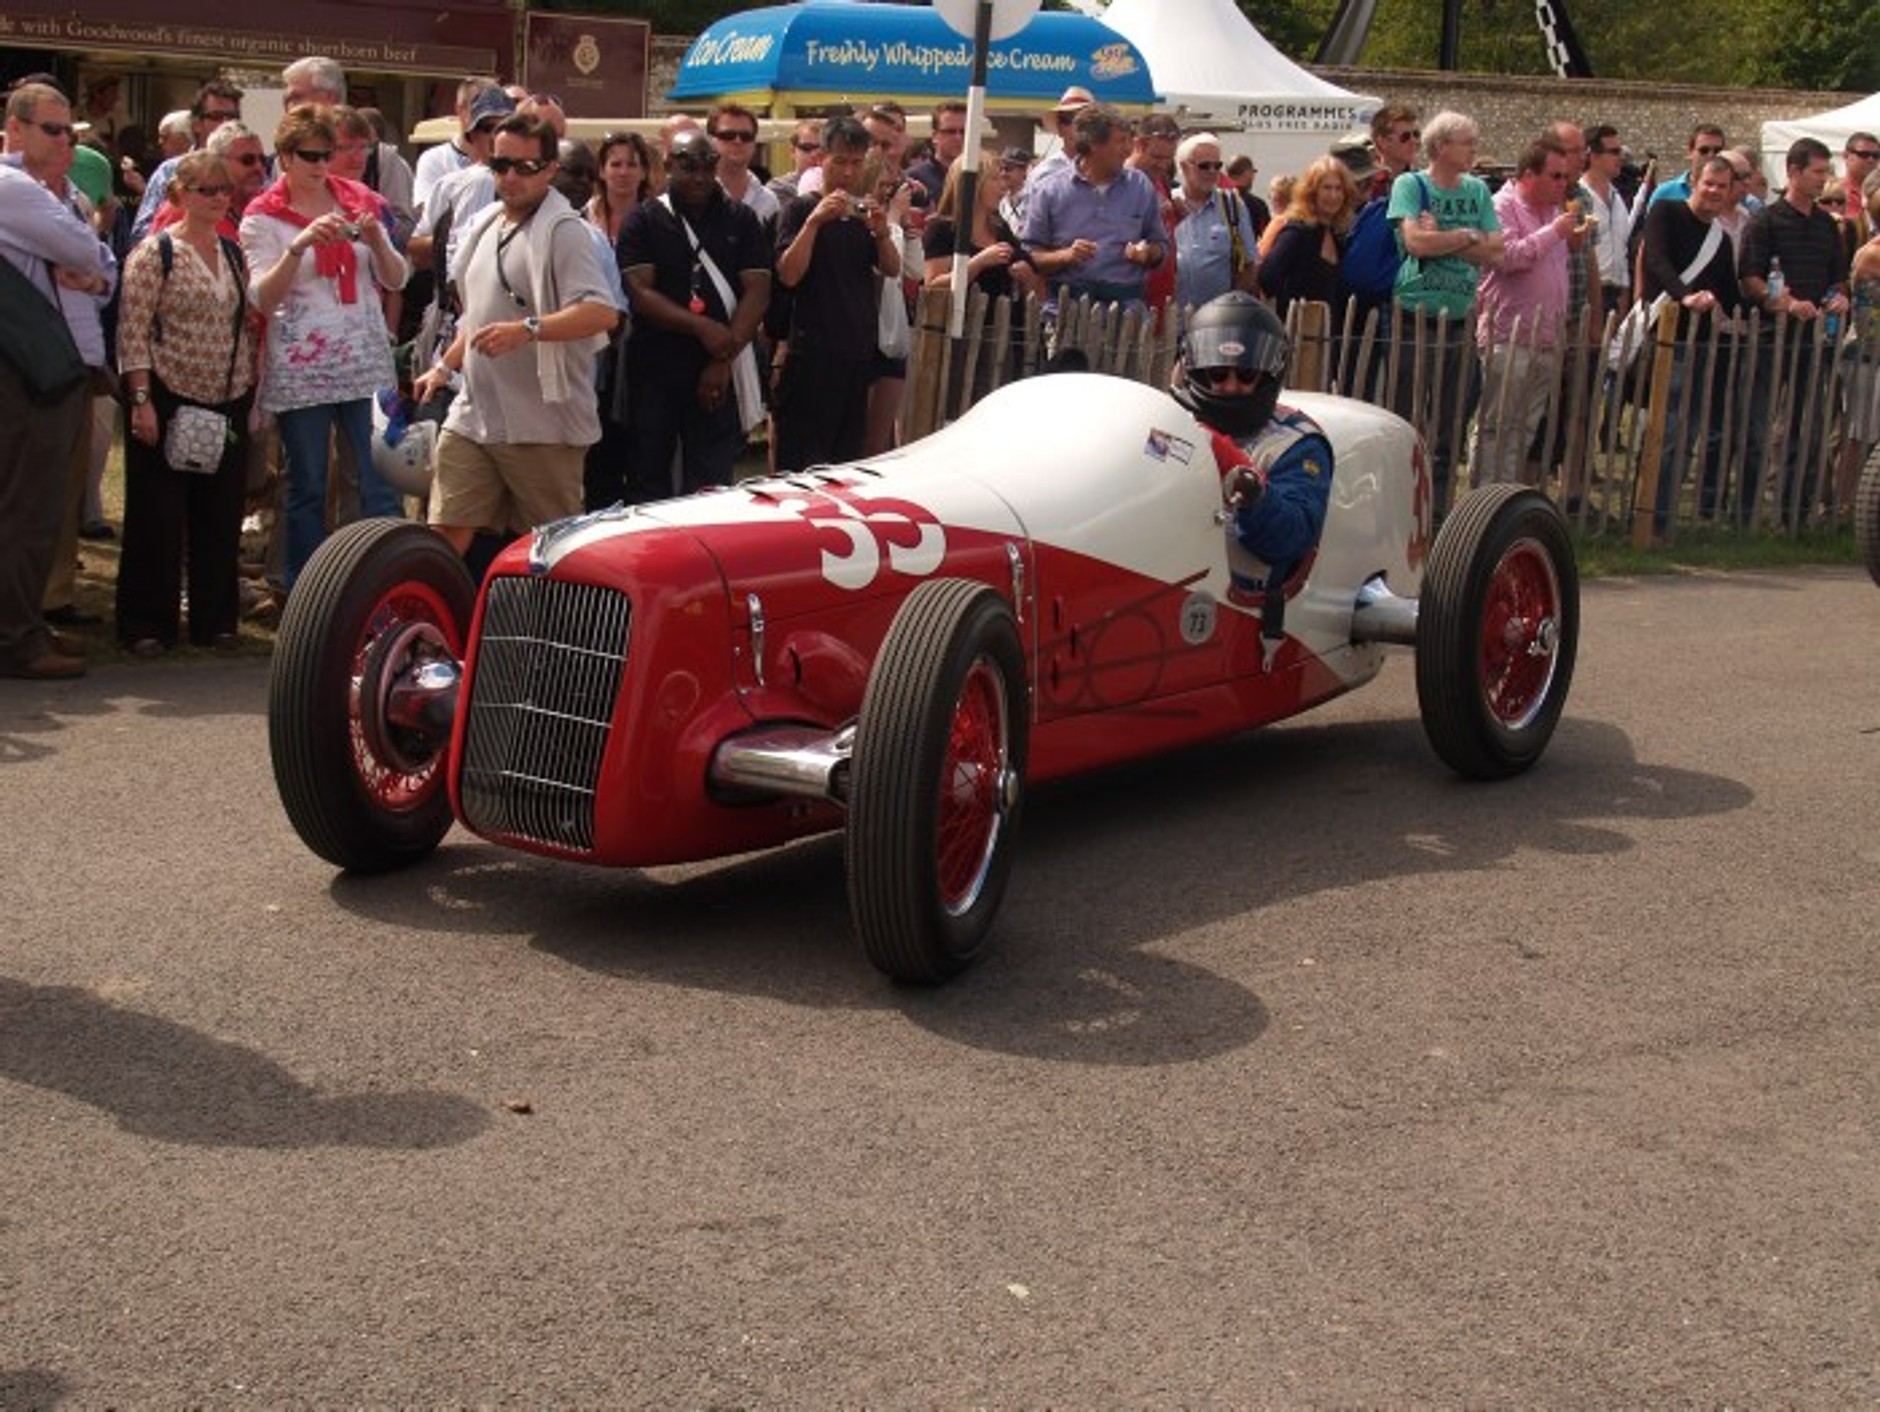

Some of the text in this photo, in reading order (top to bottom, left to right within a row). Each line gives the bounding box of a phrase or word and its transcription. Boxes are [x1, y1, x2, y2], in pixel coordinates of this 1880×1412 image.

[22, 18, 61, 37] with
[66, 20, 172, 44] Goodwood's
[177, 30, 224, 48] finest
[230, 36, 294, 56] organic
[299, 37, 378, 59] shorthorn
[383, 44, 417, 62] beef
[687, 30, 775, 68] Ice Cream
[806, 40, 880, 72] Freshly
[883, 42, 969, 75] Whipped
[1009, 47, 1077, 72] Cream
[1238, 104, 1358, 120] PROGRAMMES
